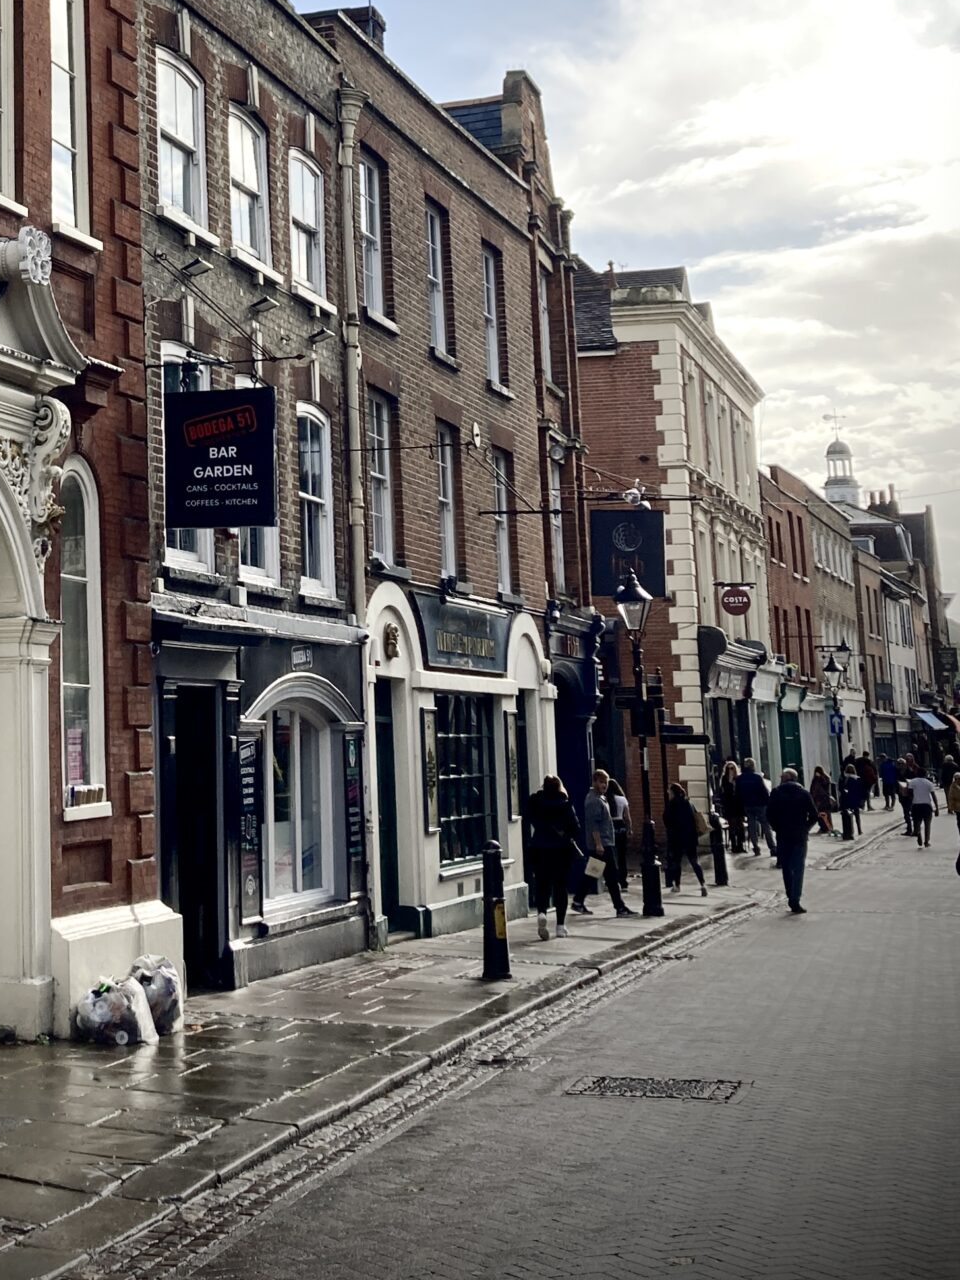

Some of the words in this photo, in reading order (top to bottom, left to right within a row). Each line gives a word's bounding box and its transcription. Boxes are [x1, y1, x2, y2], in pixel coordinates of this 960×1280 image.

[188, 416, 234, 441] BODEGA
[237, 412, 252, 427] 51
[209, 446, 238, 459] BAR
[193, 464, 253, 479] GARDEN
[186, 485, 208, 493] CANS
[214, 482, 259, 492] COCKTAILS
[185, 499, 220, 507] COFFEES
[225, 498, 258, 507] KITCHEN
[724, 596, 748, 604] COSTA
